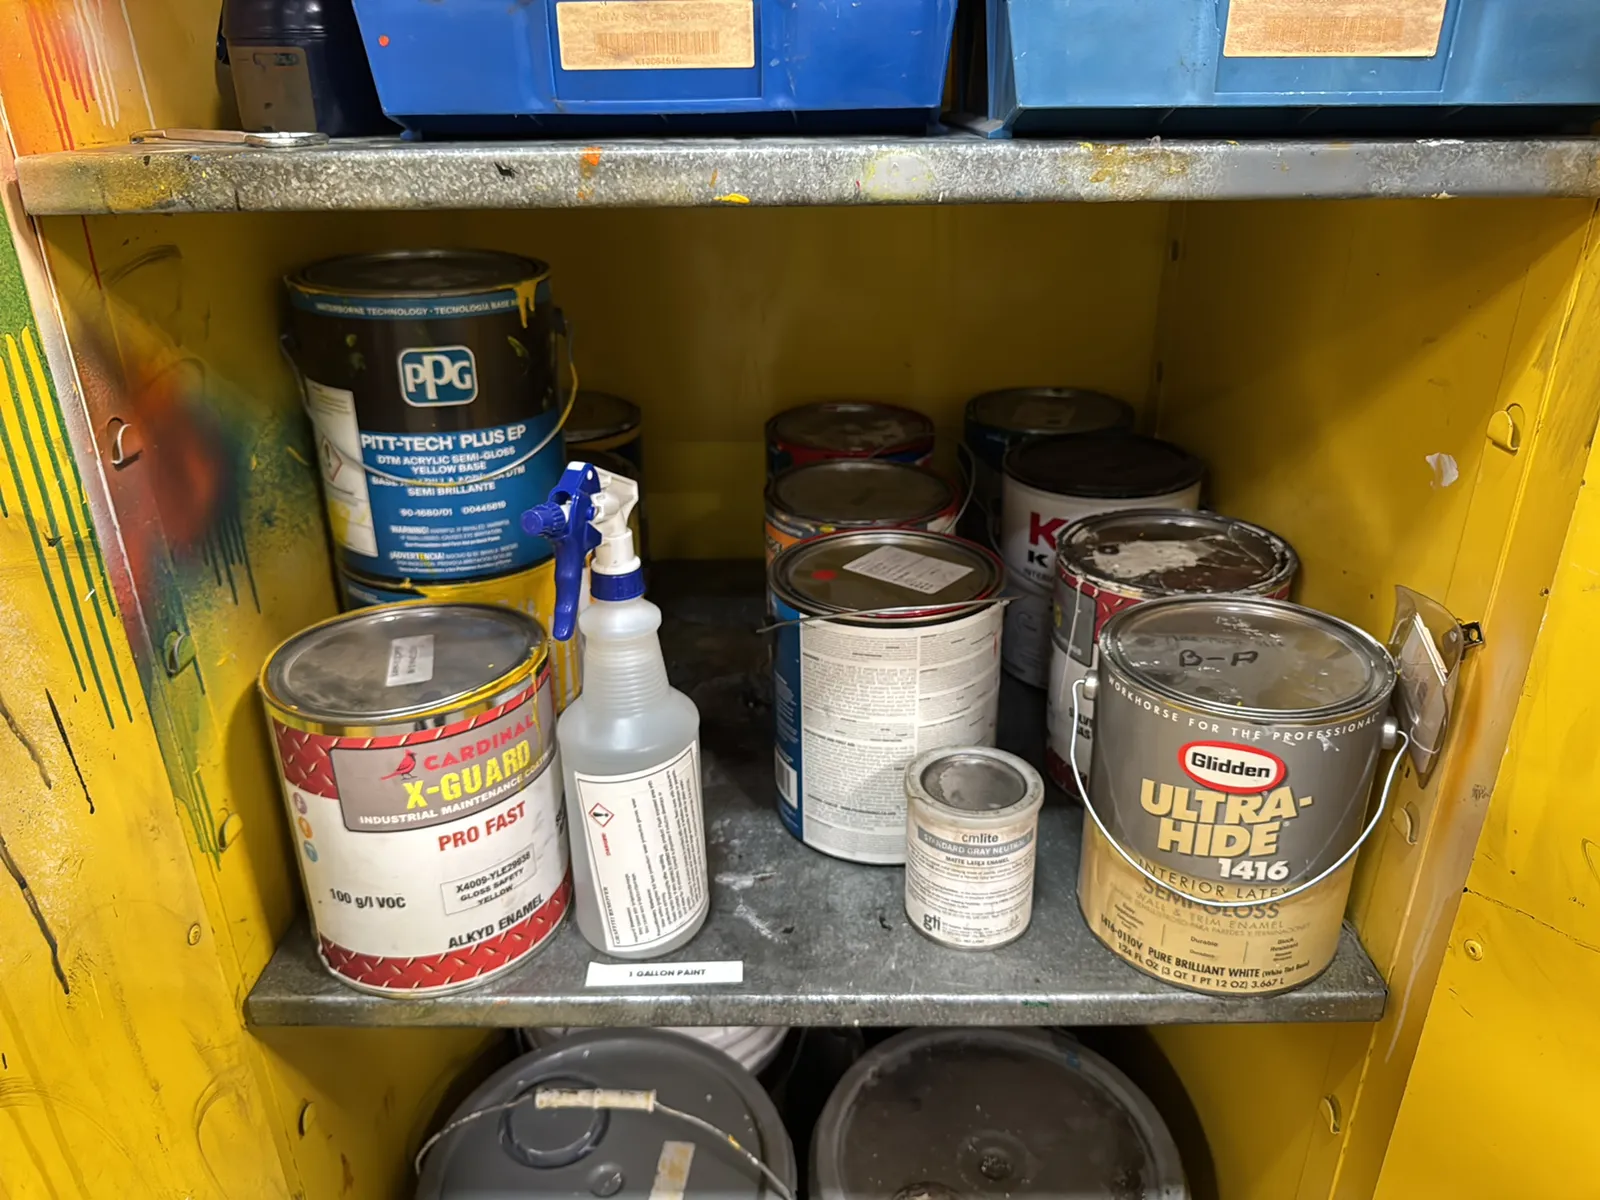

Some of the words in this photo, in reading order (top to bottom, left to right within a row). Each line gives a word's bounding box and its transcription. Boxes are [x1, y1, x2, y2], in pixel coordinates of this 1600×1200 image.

[366, 306, 429, 316] TECHNOLOGY
[404, 355, 473, 400] PPG
[360, 433, 454, 451] PITT-TECH
[460, 429, 506, 449] PLUS
[507, 424, 527, 441] EP
[376, 454, 402, 465] DTM
[402, 453, 451, 465] ACRYLIC
[451, 446, 516, 464] SEMI-GLOSS
[411, 463, 459, 475] YELLOW
[458, 461, 488, 473] BASE
[407, 486, 436, 497] SEMI
[437, 481, 497, 496] BRILLANTE
[1107, 673, 1180, 722] WORKHORSE
[1188, 717, 1220, 734] FOR
[1230, 727, 1262, 741] THE
[1272, 714, 1378, 741] PROFESSIONAL
[423, 714, 535, 772] CARDINAL
[402, 739, 532, 810] X-GUARD
[1190, 751, 1271, 779] Glidden
[359, 810, 439, 825] INDUSTRIAL
[440, 774, 524, 816] MAINTENANCE
[1139, 777, 1313, 825] ULTRA-
[437, 827, 480, 852] PRO
[485, 800, 527, 836] FAST
[961, 833, 1000, 844] cmlite
[1156, 817, 1283, 858] HIDE
[923, 833, 966, 854] STANDARD
[966, 847, 992, 857] GRAY
[944, 855, 965, 866] MATTE
[1218, 857, 1290, 881] 1416
[459, 886, 491, 902] GLOSS
[493, 867, 524, 889] SAFETY
[1138, 858, 1225, 898] INTERIOR
[329, 887, 352, 904] 100
[375, 896, 407, 909] VOC
[476, 883, 514, 906] YELLOW
[448, 921, 495, 950] ALKYD
[498, 892, 545, 931] ENAMEL
[922, 913, 941, 931] gti
[1228, 919, 1285, 931] ENAMEL
[636, 969, 676, 978] GALLON
[676, 968, 707, 977] PAINT
[1118, 941, 1133, 957] 124
[1134, 951, 1144, 963] FL
[1145, 957, 1159, 971] OZ
[1161, 964, 1171, 976] (3
[1173, 970, 1188, 980] QT
[1200, 976, 1212, 986] PT
[1216, 978, 1228, 988] 12
[1230, 979, 1248, 989] OZ)
[1147, 946, 1173, 965] PURE
[1174, 957, 1226, 977] BRILLIANT
[1229, 967, 1261, 978] WHITE
